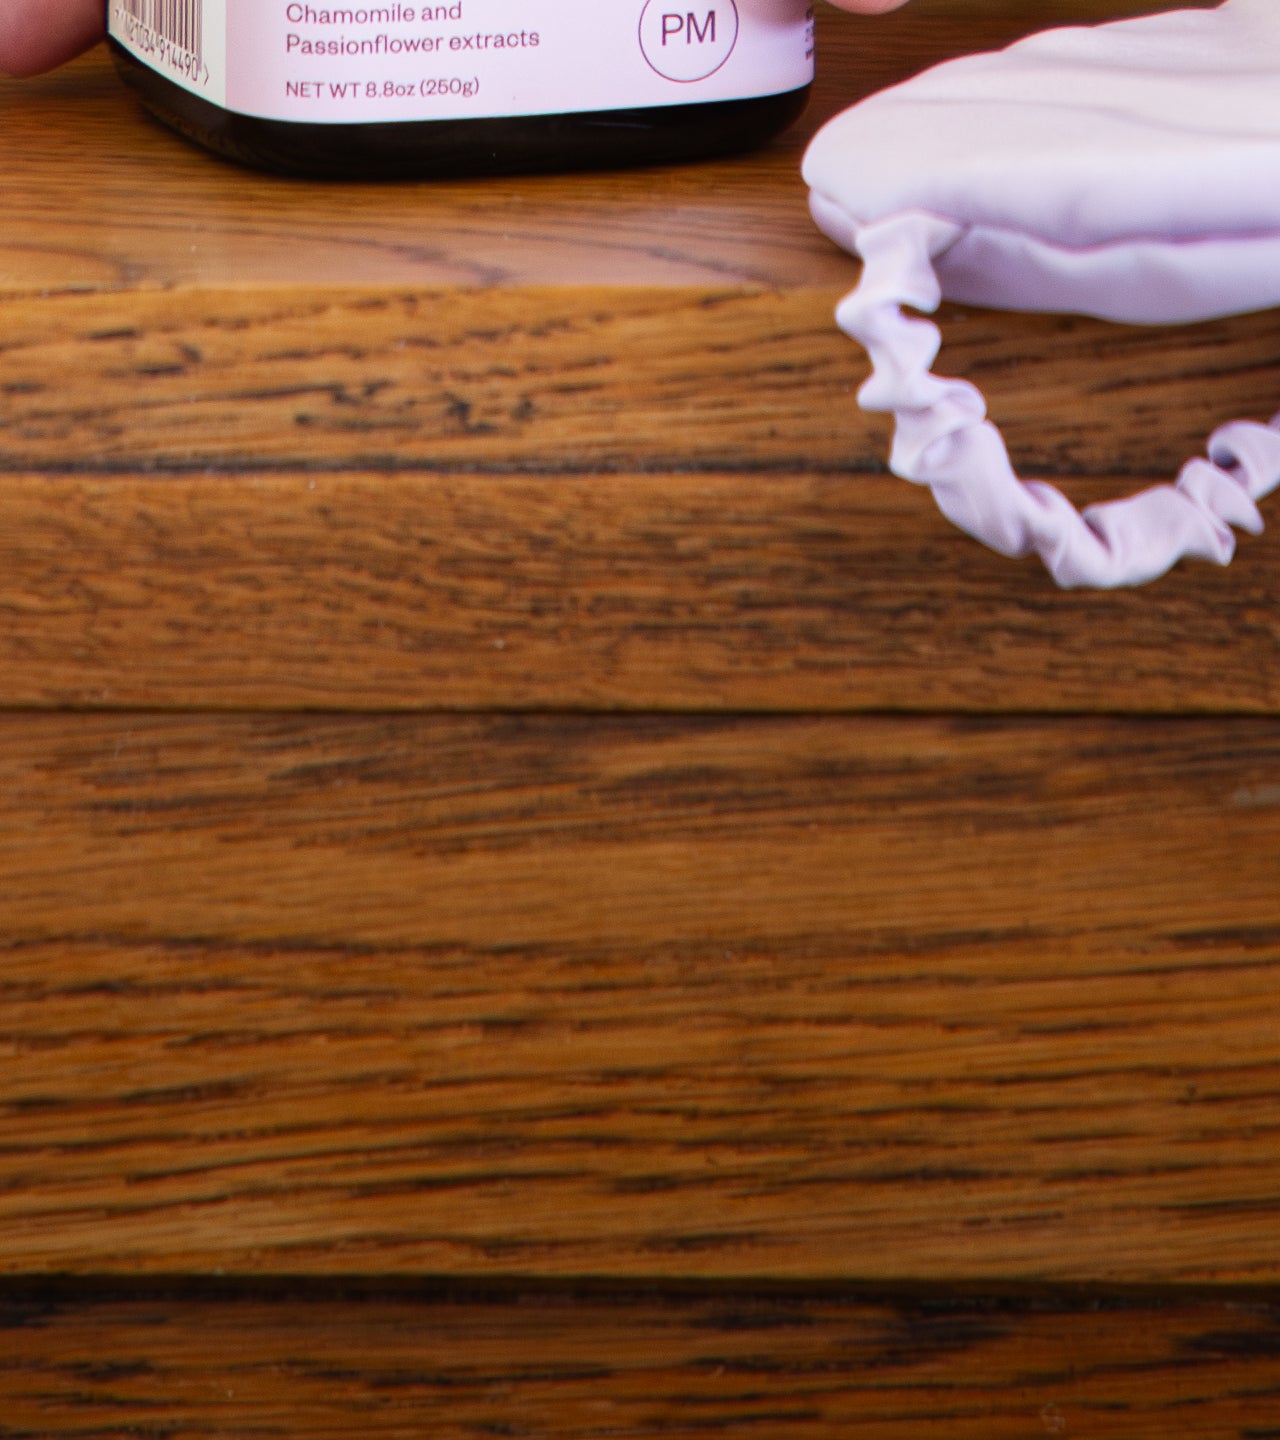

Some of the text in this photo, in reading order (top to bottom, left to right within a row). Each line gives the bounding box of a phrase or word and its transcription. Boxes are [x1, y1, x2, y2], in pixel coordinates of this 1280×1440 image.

[286, 0, 463, 25] Chamomile and
[661, 9, 717, 47] PM
[286, 28, 541, 56] Passionflower extracts
[285, 76, 480, 99] NET WT 8.8oz (250g)
